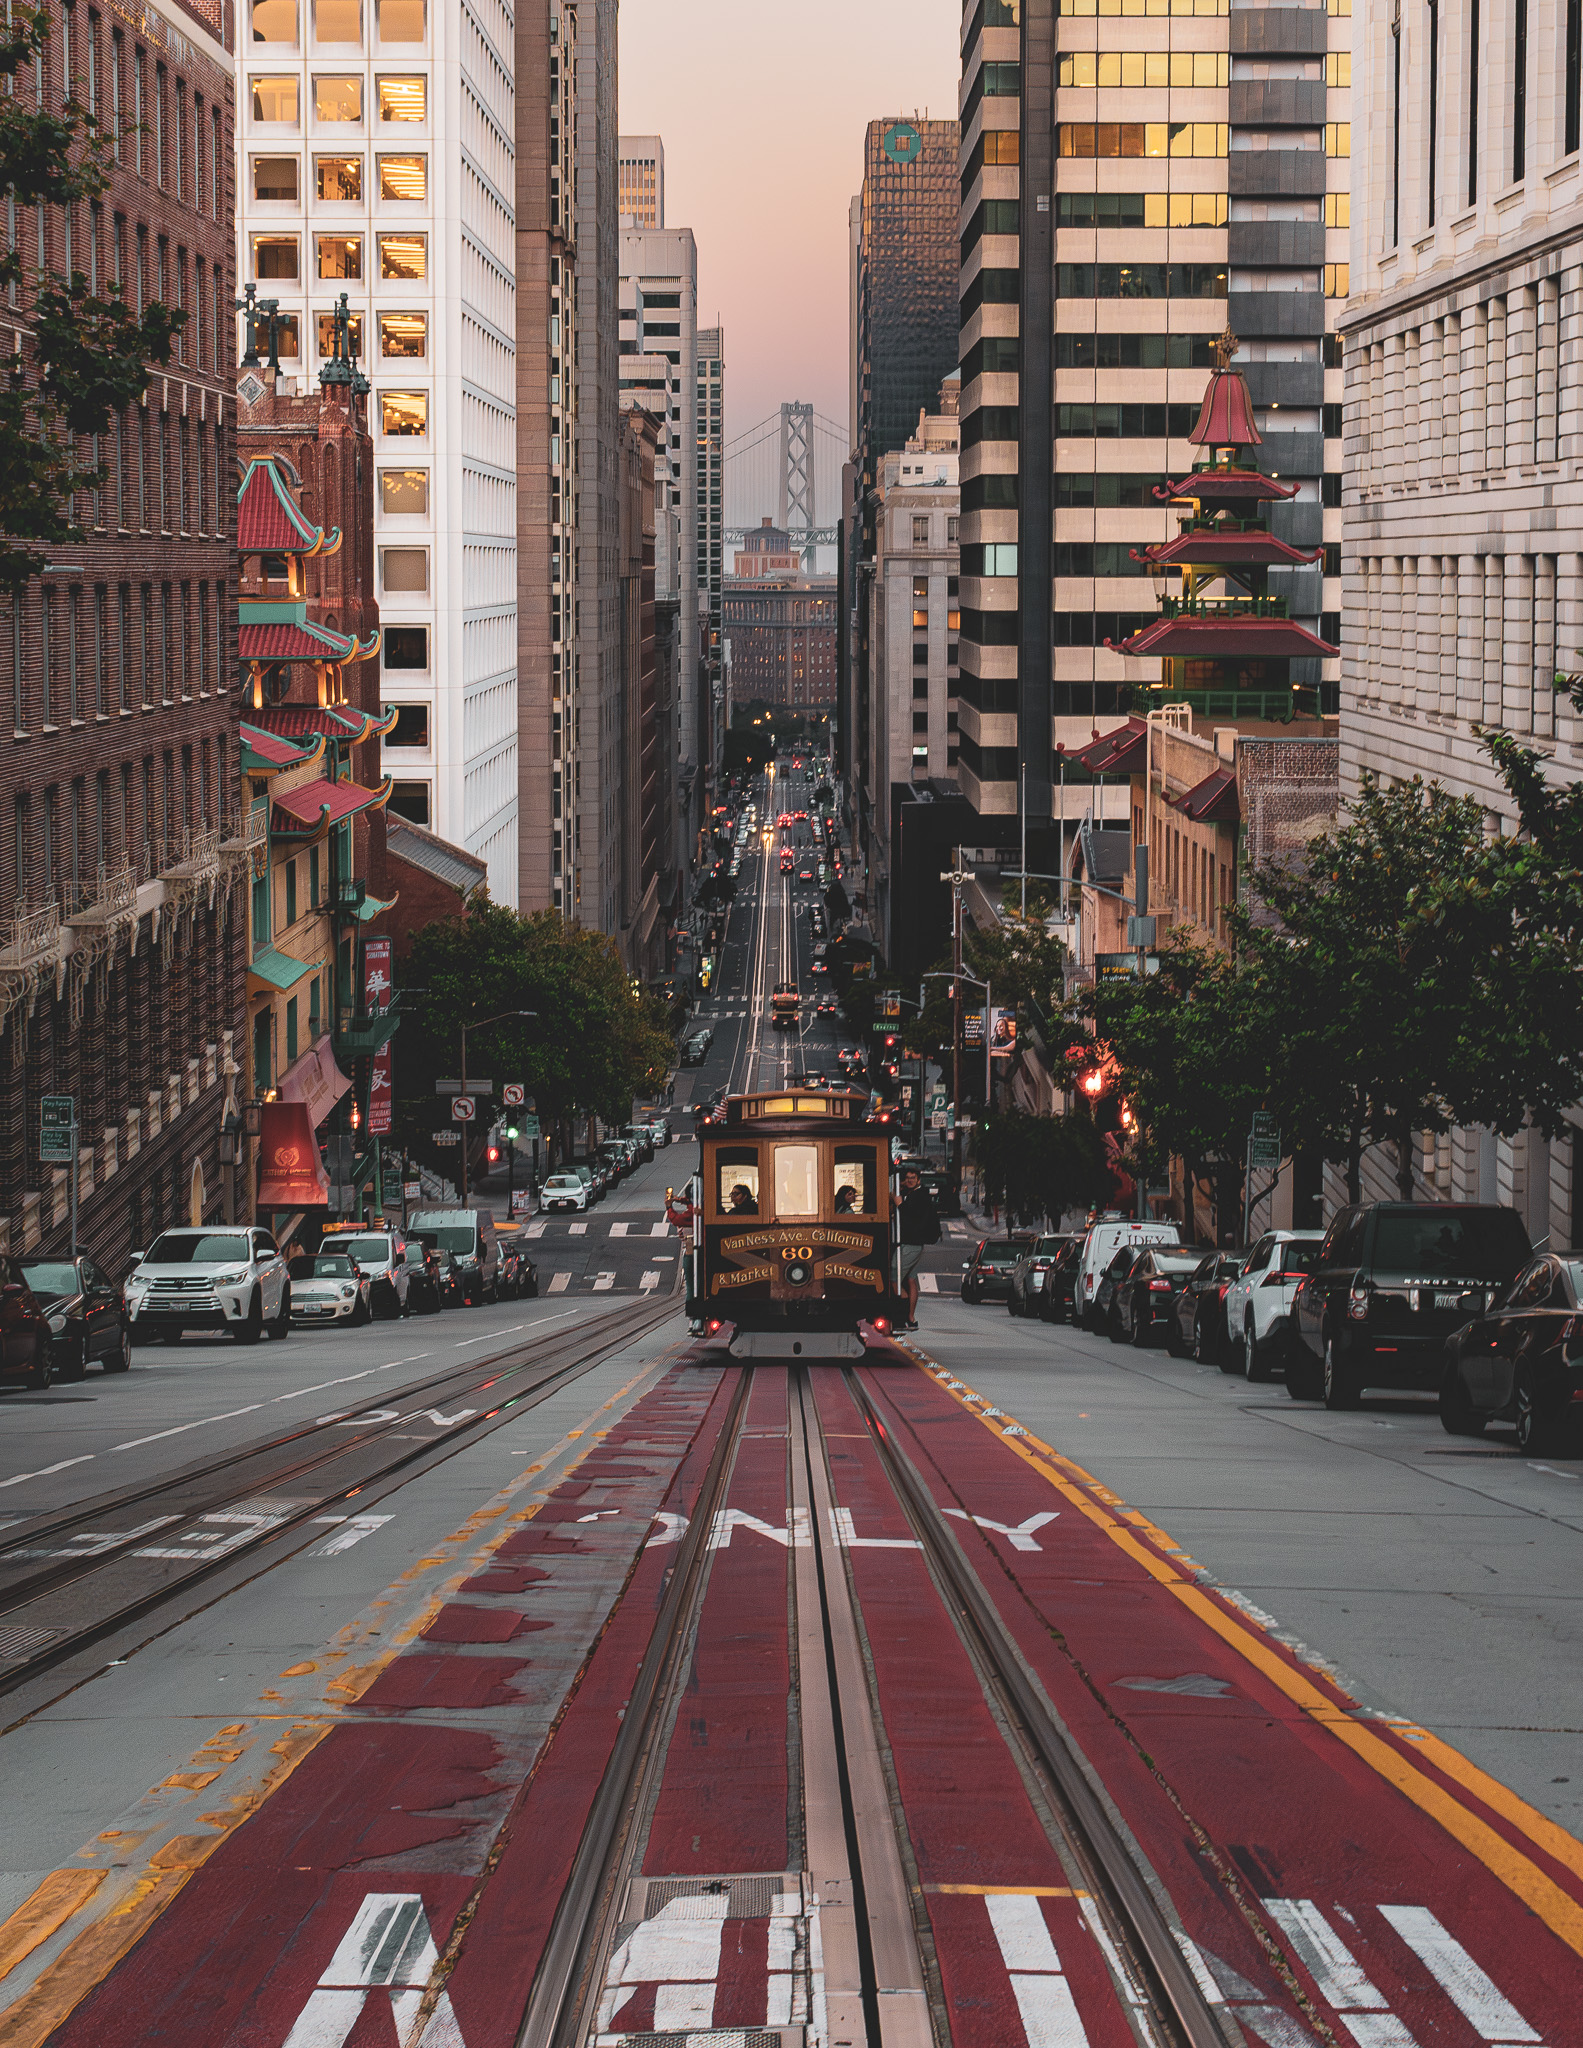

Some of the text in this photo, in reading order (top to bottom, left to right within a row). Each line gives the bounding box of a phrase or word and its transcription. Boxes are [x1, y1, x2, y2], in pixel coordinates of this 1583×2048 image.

[724, 1238, 745, 1250] Van
[746, 1233, 775, 1247] Ness
[812, 1230, 871, 1248] California
[781, 1246, 813, 1260] 60
[719, 1263, 875, 1285] & Market Streets
[1403, 1278, 1502, 1287] RANGE ROVER
